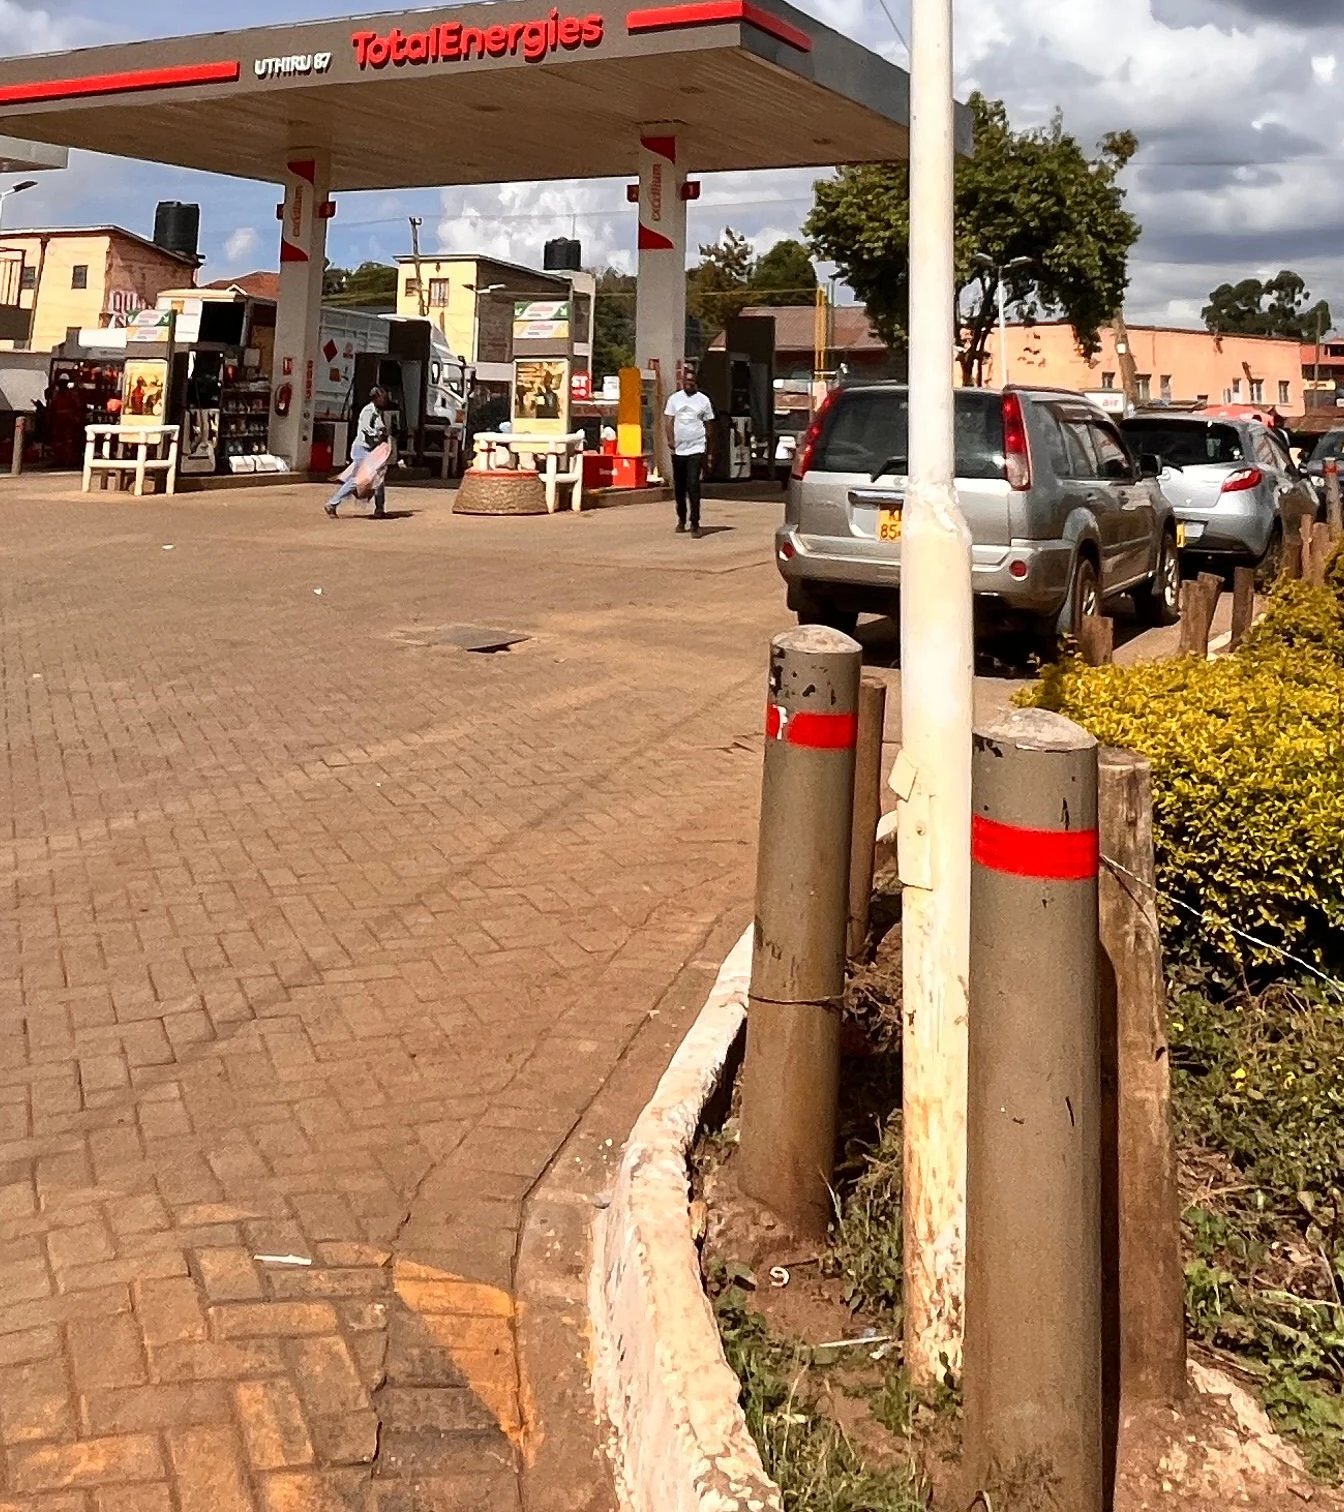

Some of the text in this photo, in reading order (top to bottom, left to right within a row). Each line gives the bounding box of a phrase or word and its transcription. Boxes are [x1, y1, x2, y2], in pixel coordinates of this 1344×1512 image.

[352, 7, 603, 69] TotalEnergies
[255, 51, 332, 76] UTHIRU 87
